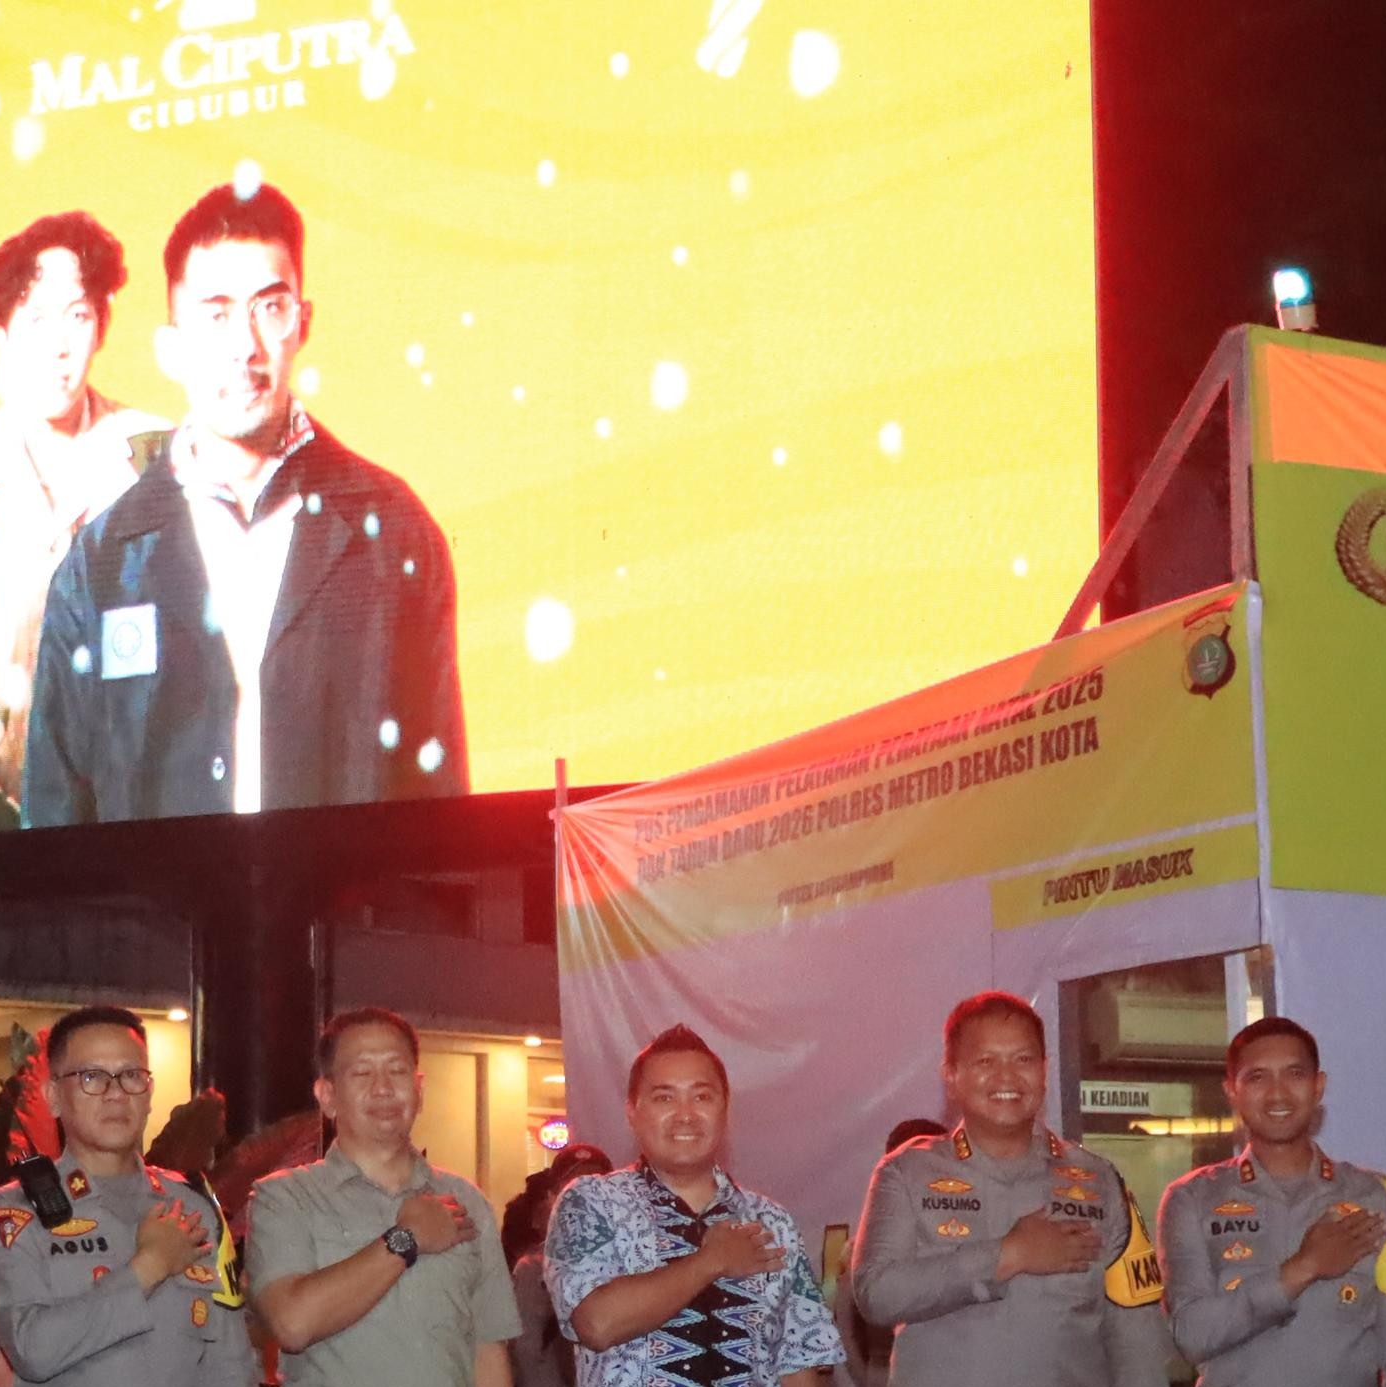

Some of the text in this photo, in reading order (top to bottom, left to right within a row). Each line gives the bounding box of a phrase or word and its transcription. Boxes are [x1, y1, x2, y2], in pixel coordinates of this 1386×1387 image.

[30, 14, 413, 114] MAL CIPUTRA
[129, 81, 306, 131] CIBUBUR
[1042, 665, 1104, 717] 2025
[769, 801, 814, 849] 2026
[817, 781, 884, 833] POLRES
[888, 760, 955, 811] METRO
[959, 735, 1035, 791] BEKASI
[1040, 715, 1100, 767] KOTA
[1043, 848, 1195, 906] PINTU MASUK
[1091, 1090, 1150, 1107] KEJADIAN
[922, 1197, 981, 1212] KUSUMO
[1051, 1201, 1105, 1220] POLRI
[1211, 1220, 1260, 1236] BAYU
[50, 1236, 109, 1256] AGUS
